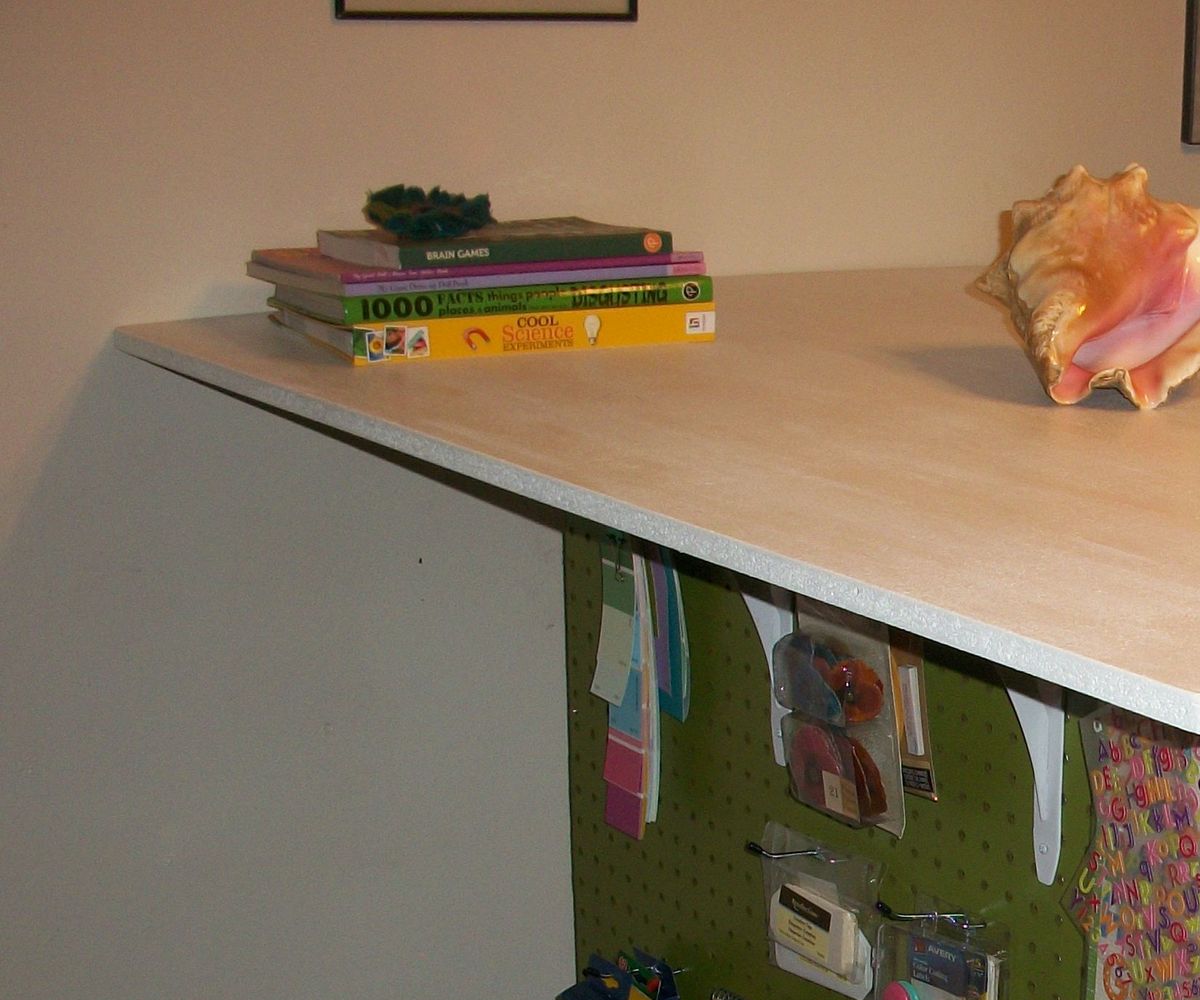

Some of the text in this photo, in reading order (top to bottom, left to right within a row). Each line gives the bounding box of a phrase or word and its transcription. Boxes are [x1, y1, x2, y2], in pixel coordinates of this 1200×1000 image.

[426, 247, 490, 261] BRAIN GAMES
[438, 291, 484, 306] FACTS
[488, 290, 521, 304] things
[361, 295, 434, 321] 1000
[439, 304, 475, 318] places
[484, 302, 527, 314] animals
[517, 315, 559, 329] COOL
[502, 324, 574, 342] Science
[503, 339, 574, 352] EXPERIMENTS
[927, 944, 957, 962] AVERY
